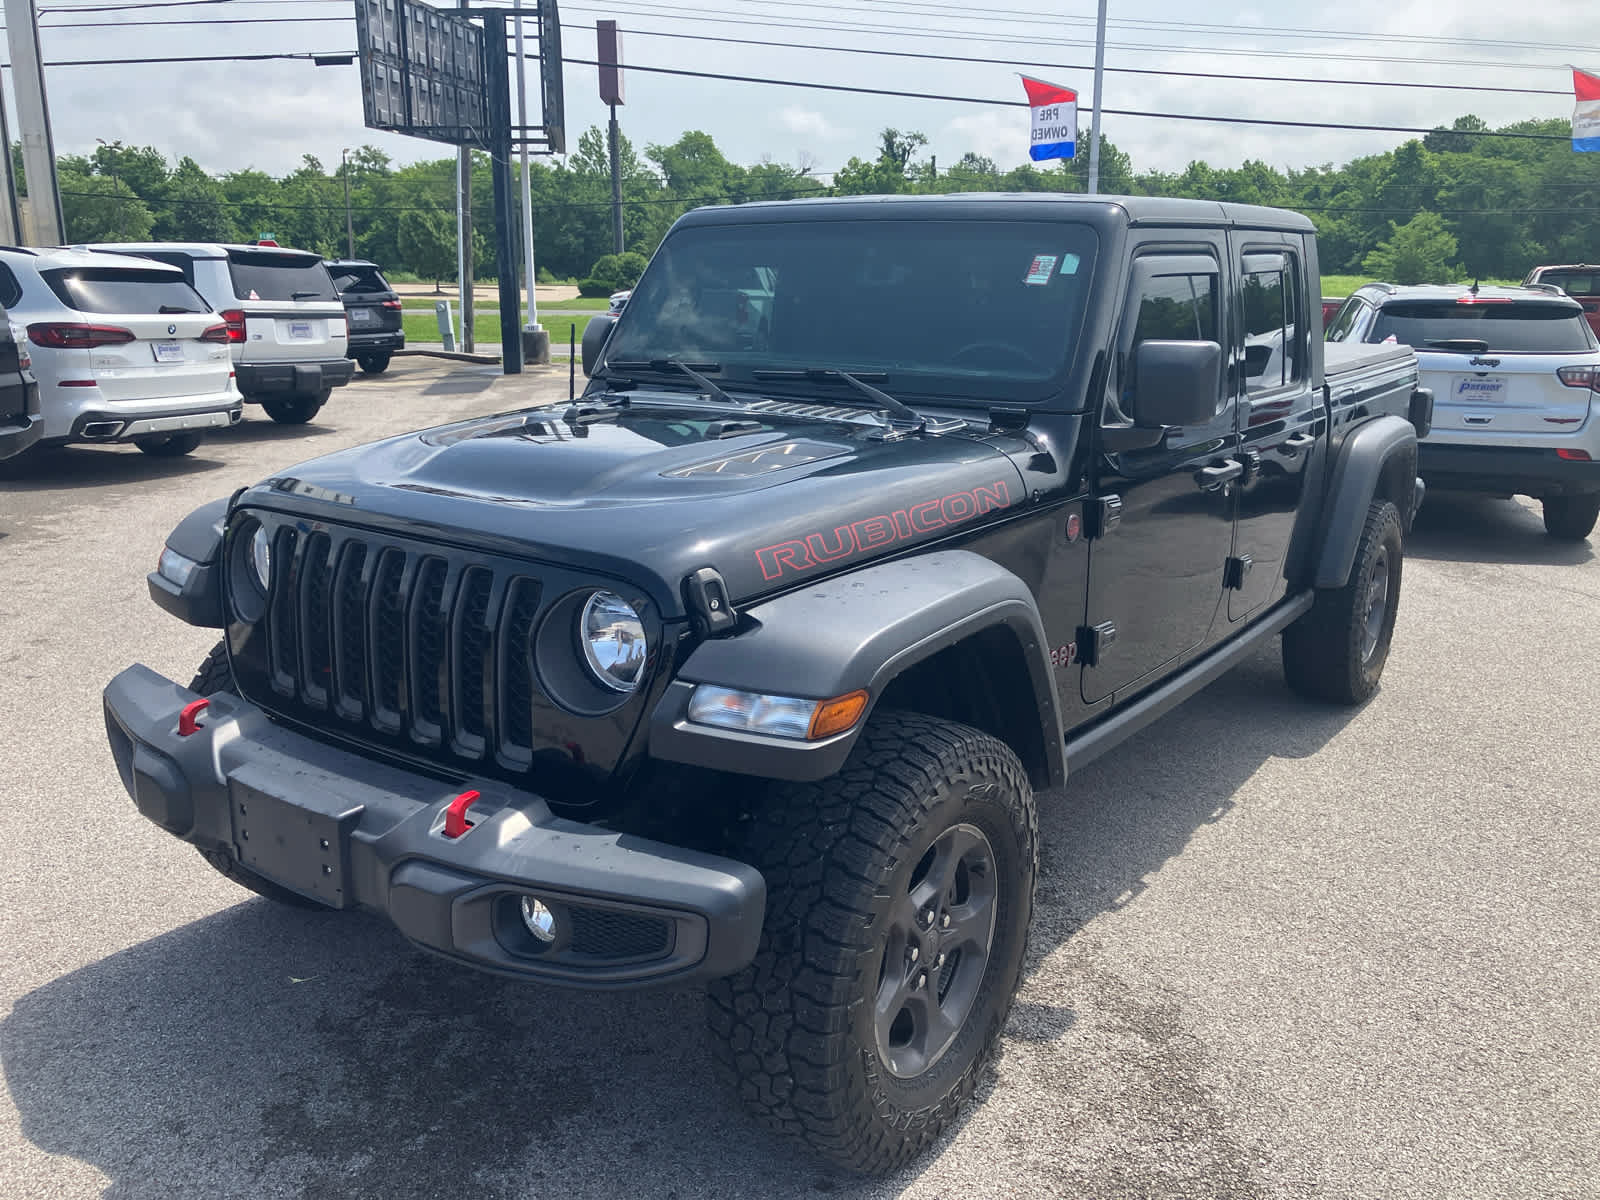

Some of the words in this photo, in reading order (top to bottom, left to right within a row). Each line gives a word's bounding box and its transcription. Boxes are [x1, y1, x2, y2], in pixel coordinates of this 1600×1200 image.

[1469, 356, 1501, 368] Jeep
[754, 480, 1011, 581] RUBICON
[1049, 640, 1078, 668] eep
